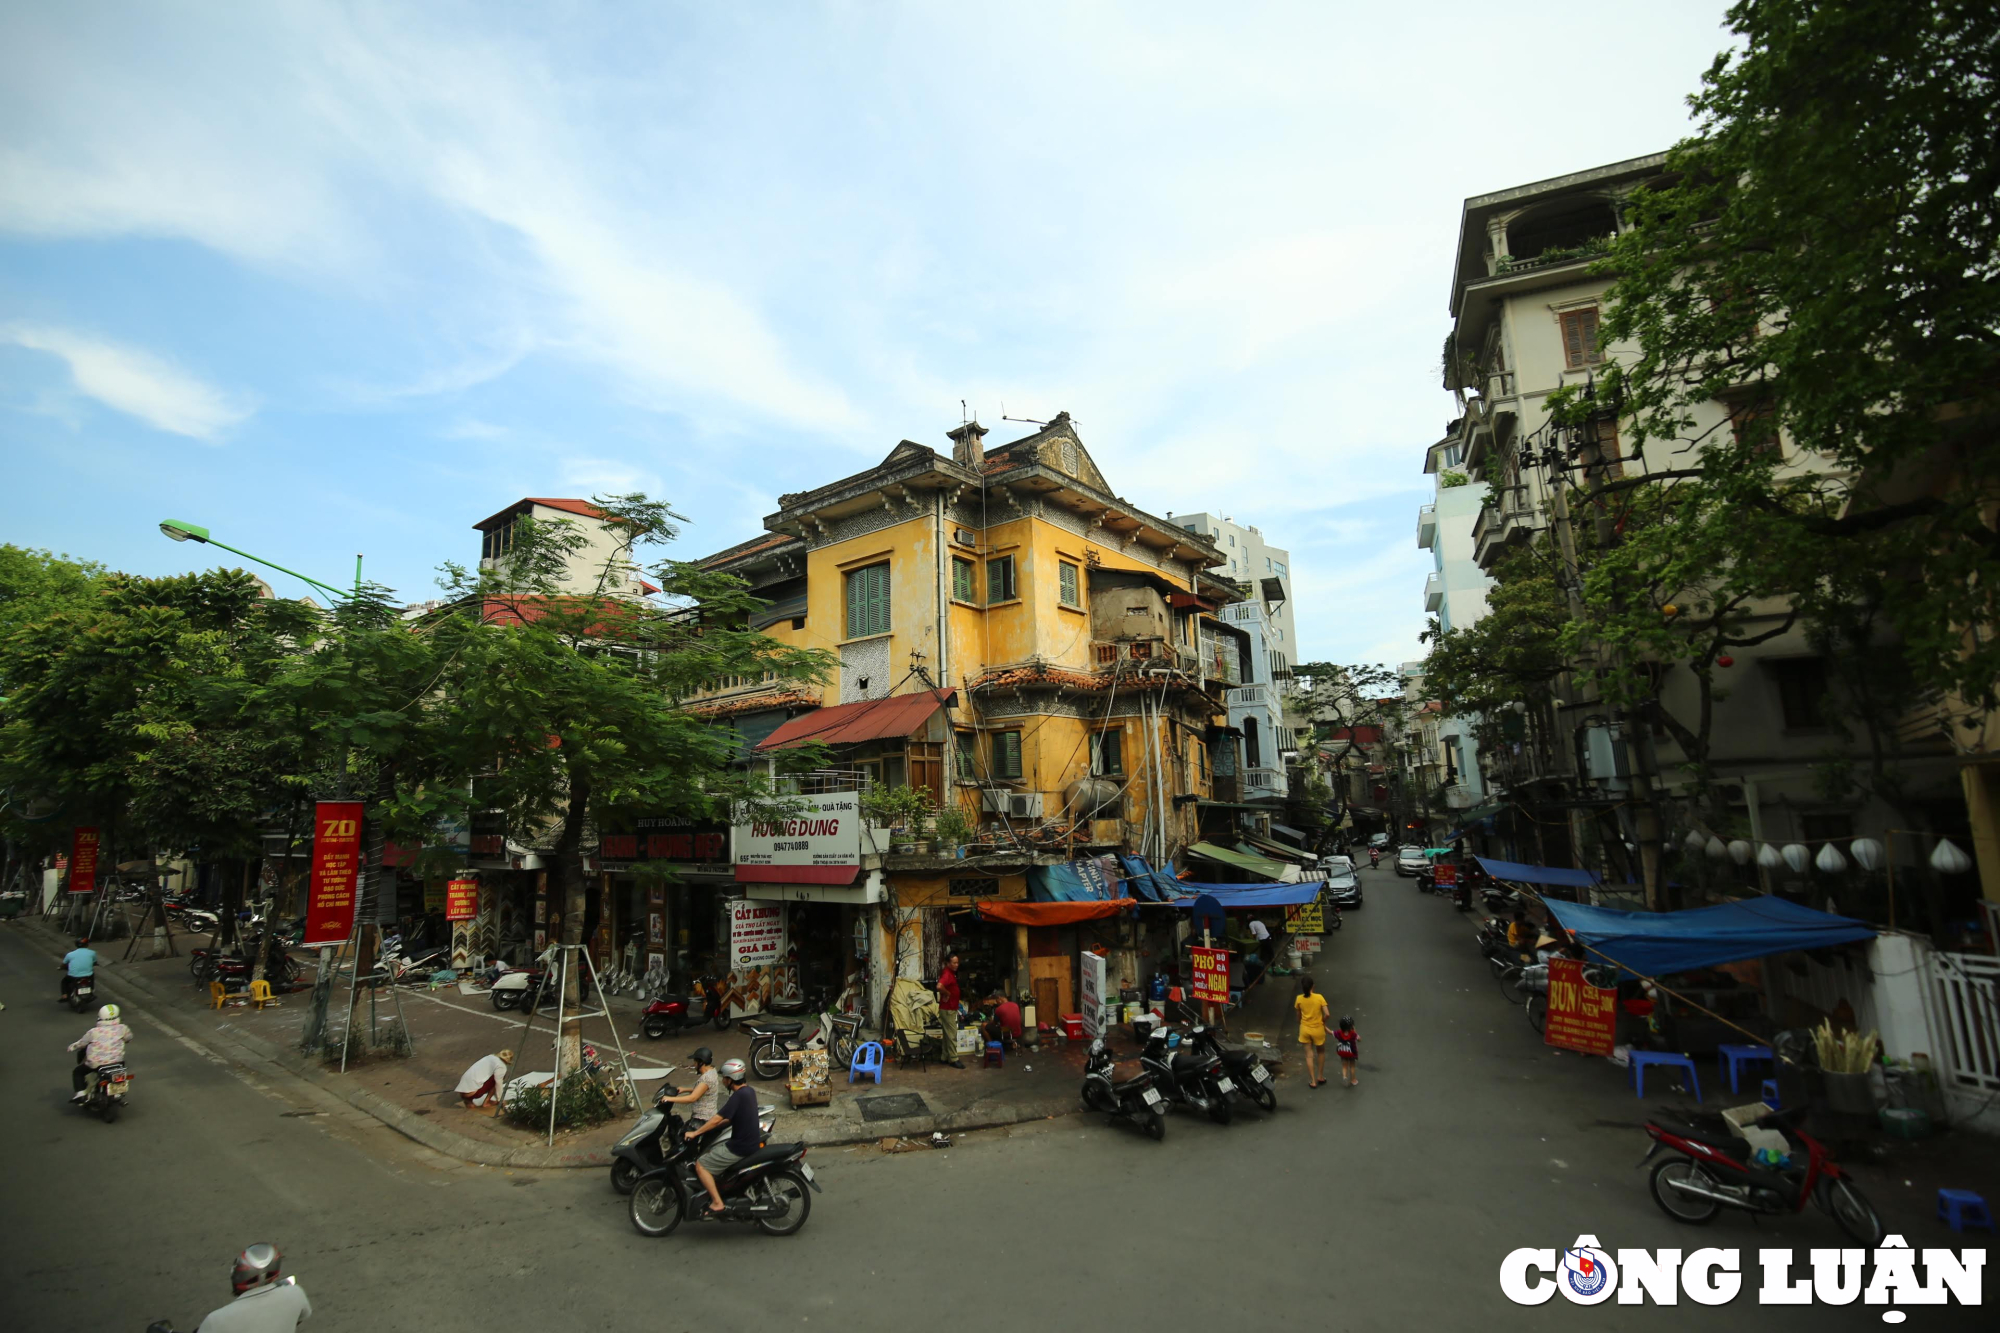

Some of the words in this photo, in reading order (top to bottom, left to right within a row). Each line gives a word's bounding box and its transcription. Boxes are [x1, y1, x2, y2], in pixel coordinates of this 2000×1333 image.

[822, 802, 835, 812] QUÀ
[836, 801, 852, 812] TẶNG
[638, 819, 656, 828] HUY
[798, 819, 840, 836] DUNG
[735, 904, 751, 920] CẮT
[753, 907, 780, 919] KHUNG
[738, 944, 759, 954] GIÁ
[762, 941, 776, 951] RẺ
[1193, 951, 1215, 970] PHỞ
[1216, 952, 1225, 961] BÒ
[1216, 964, 1226, 972] GÀ
[1208, 973, 1227, 992] NGAN
[1550, 972, 1577, 1012] BÚN
[1582, 1002, 1599, 1018] NEM
